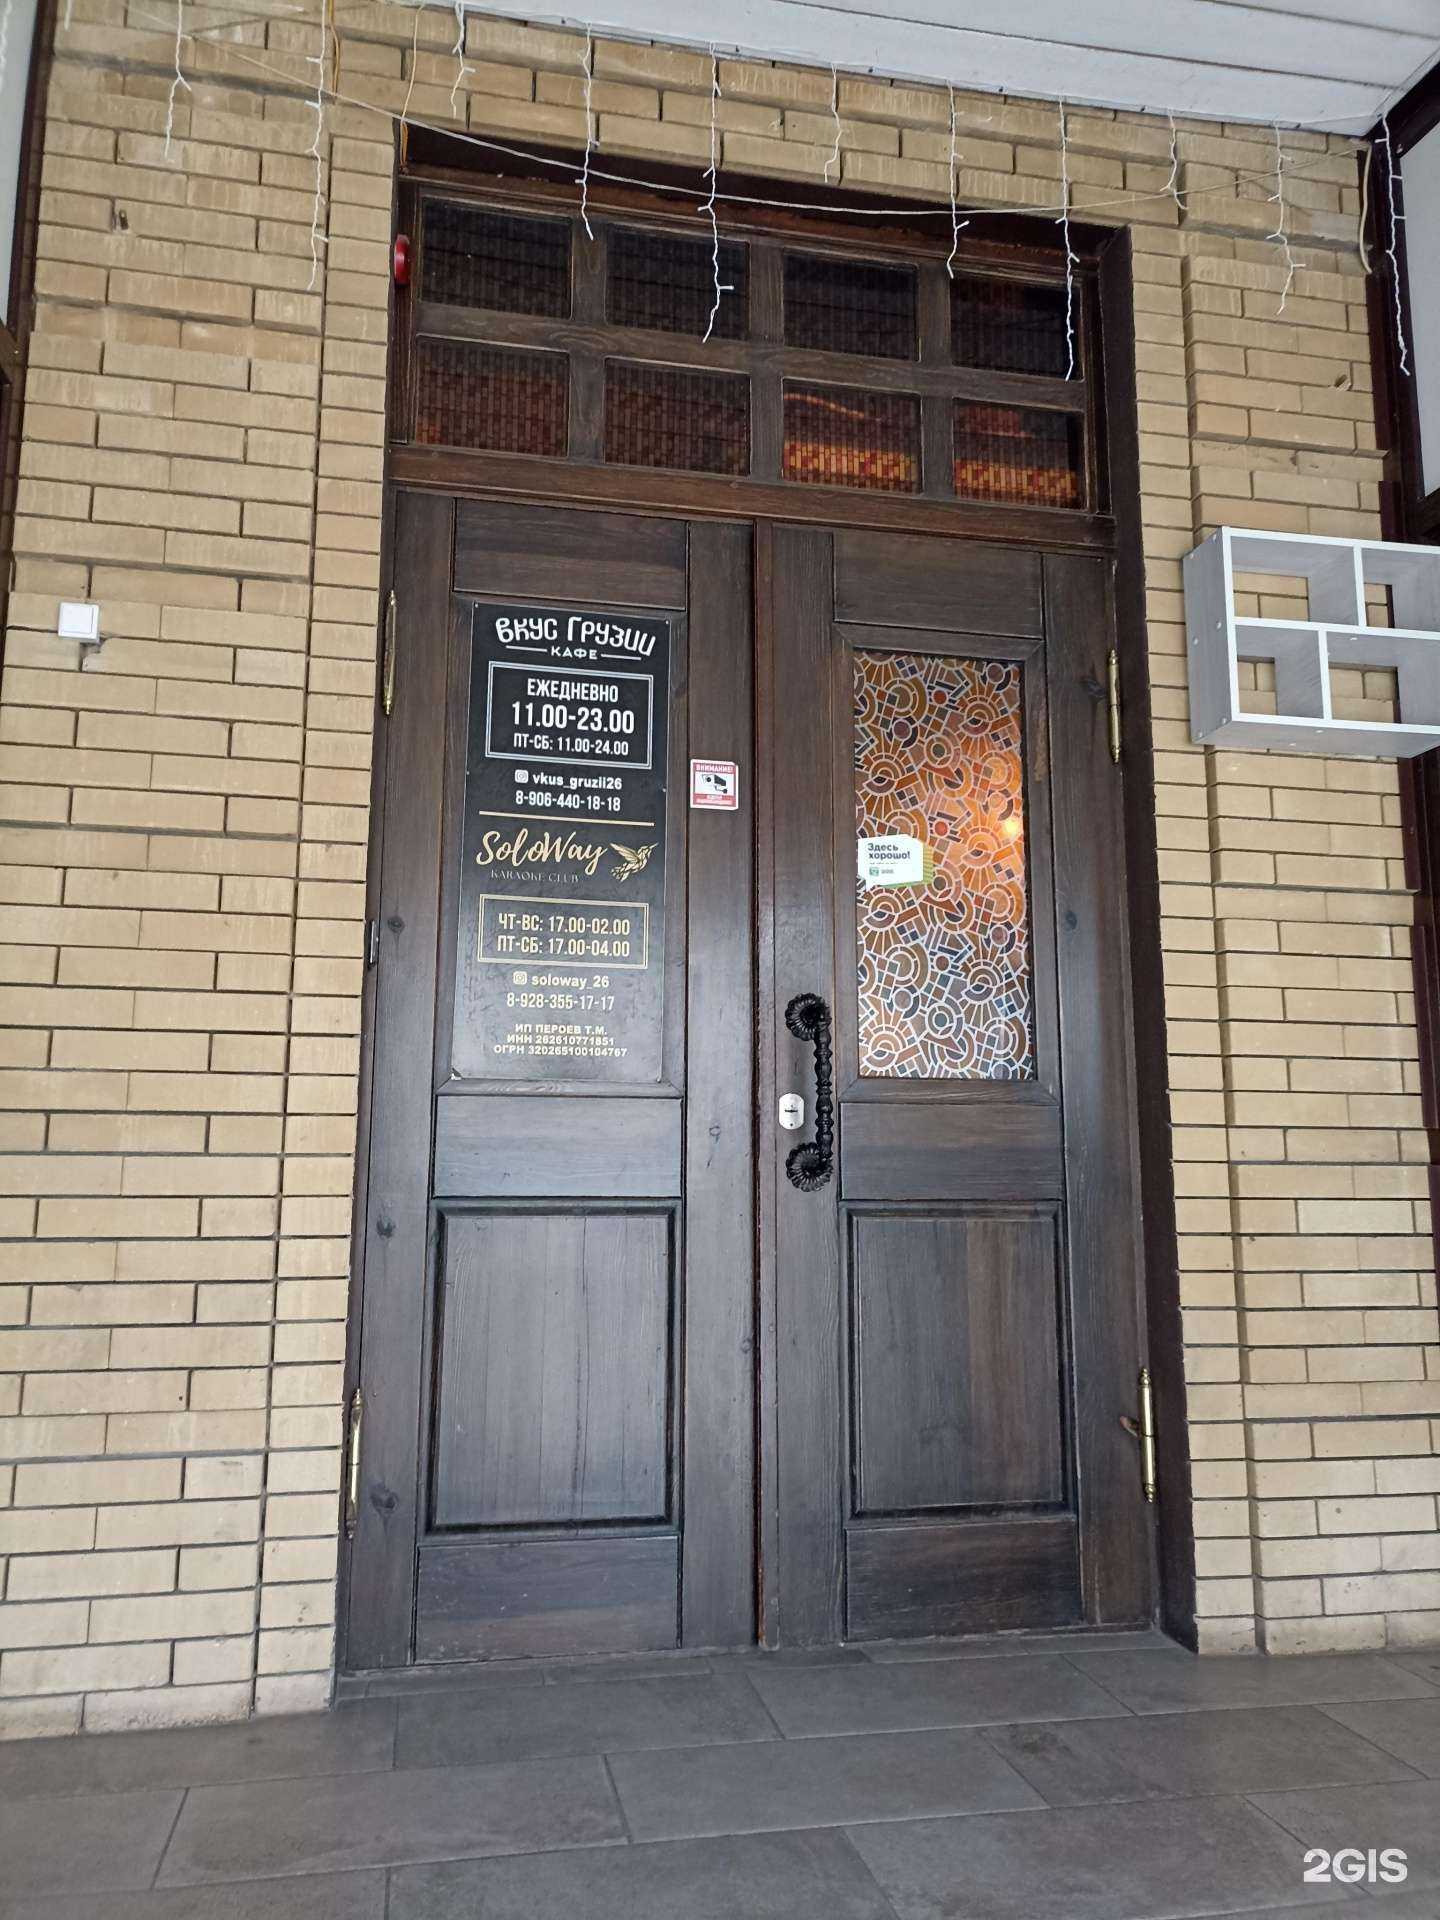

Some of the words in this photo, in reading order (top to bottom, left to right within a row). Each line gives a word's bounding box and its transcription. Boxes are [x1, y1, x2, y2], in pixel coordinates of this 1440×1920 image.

[551, 646, 598, 660] КАФЕ
[527, 678, 619, 703] ЕЖЕДНЕВНО
[512, 701, 635, 734] 11.00-23.00
[514, 733, 553, 750] ПТ-СБ:
[557, 736, 629, 756] 11.00-24.00
[532, 772, 623, 790] vkus_gruzii26
[515, 790, 621, 811] 8-906-440-18-18
[476, 828, 608, 876] SoloWay
[868, 843, 899, 852] Здесь
[868, 851, 911, 860] хорошо!
[491, 869, 545, 881] KARAOKE
[549, 872, 579, 883] CLUB
[499, 913, 543, 931] ЧТ-ВС:
[549, 916, 630, 935] 17.00-02.00
[497, 935, 543, 953] ПТ-СБ:
[548, 938, 630, 957] 17.00-04.00
[531, 973, 610, 990] soloway_26
[506, 992, 615, 1011] 8-928-355-17-17
[515, 1023, 532, 1032] ИП
[535, 1024, 581, 1034] ПЕРОЕВ
[584, 1025, 608, 1035] Т.М.
[494, 1045, 524, 1054] ОГРН
[507, 1035, 533, 1044] ИНН
[535, 1035, 614, 1046] 262610771851
